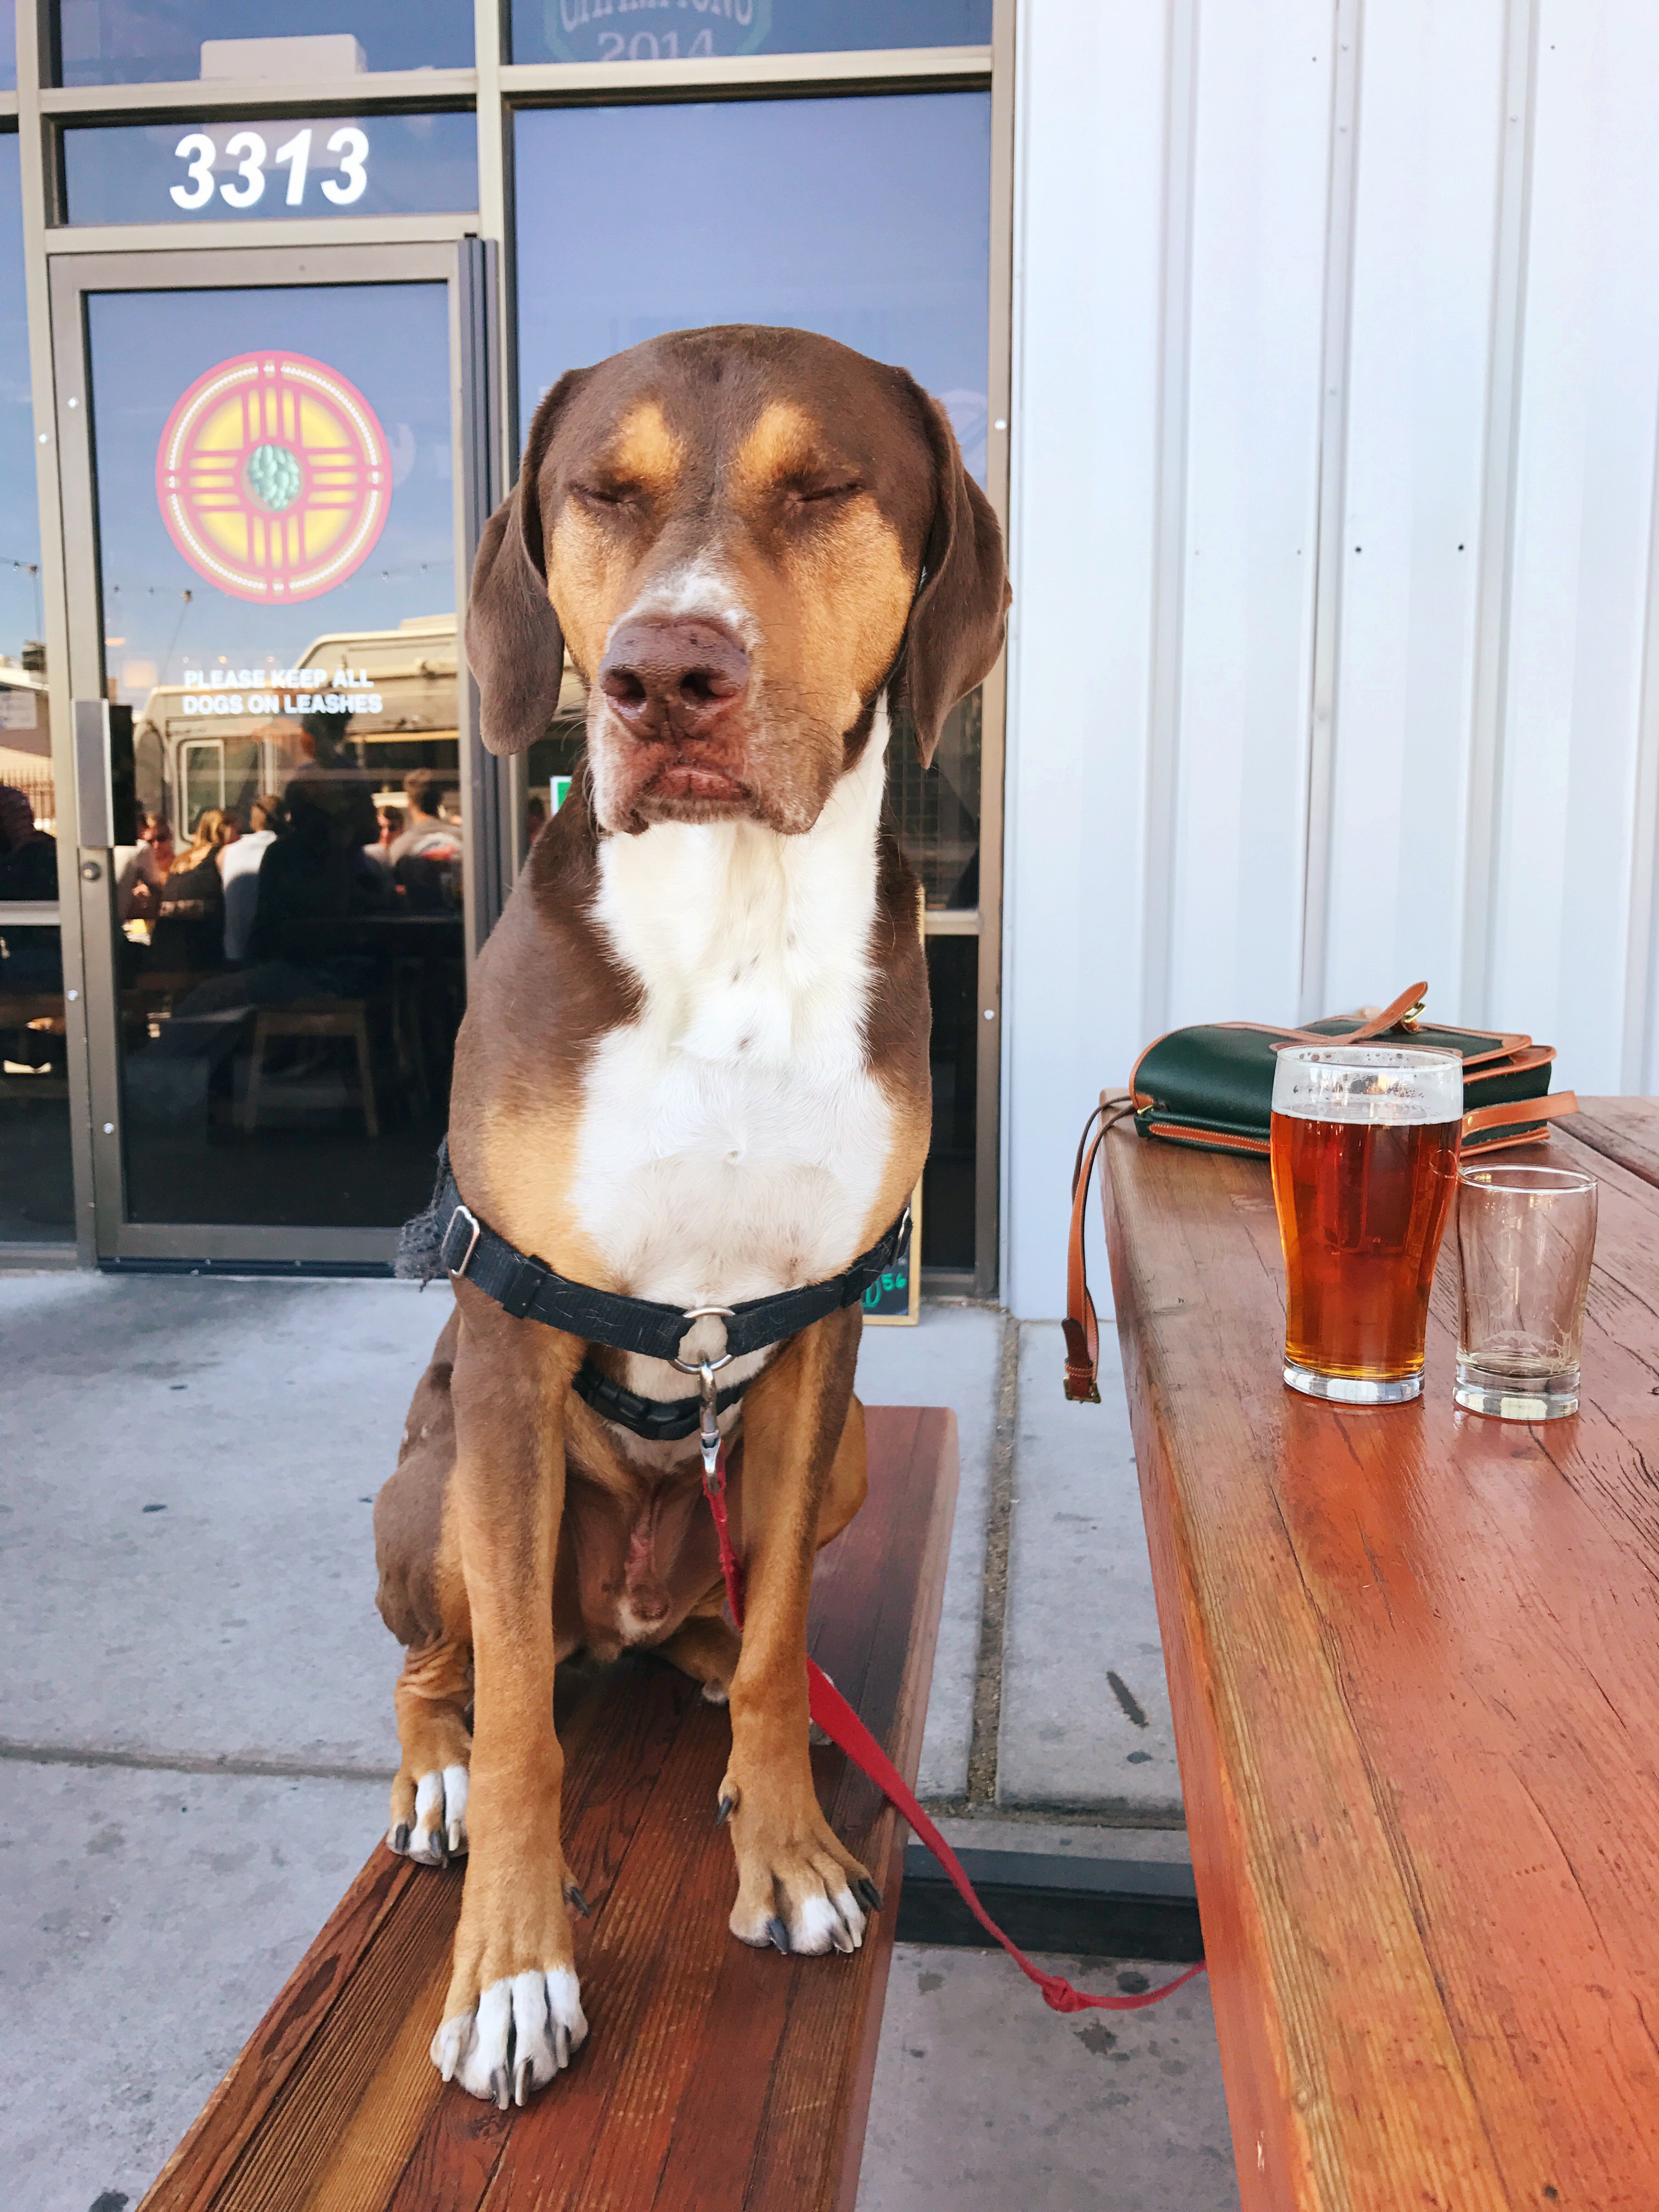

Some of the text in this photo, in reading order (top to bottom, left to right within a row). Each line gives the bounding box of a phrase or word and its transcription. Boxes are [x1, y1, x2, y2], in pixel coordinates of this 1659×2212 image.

[597, 28, 715, 61] 2014
[170, 127, 369, 210] 3313
[184, 668, 374, 689] PLEASE KEEP ALL
[182, 693, 383, 714] DOGS ON LEASHES
